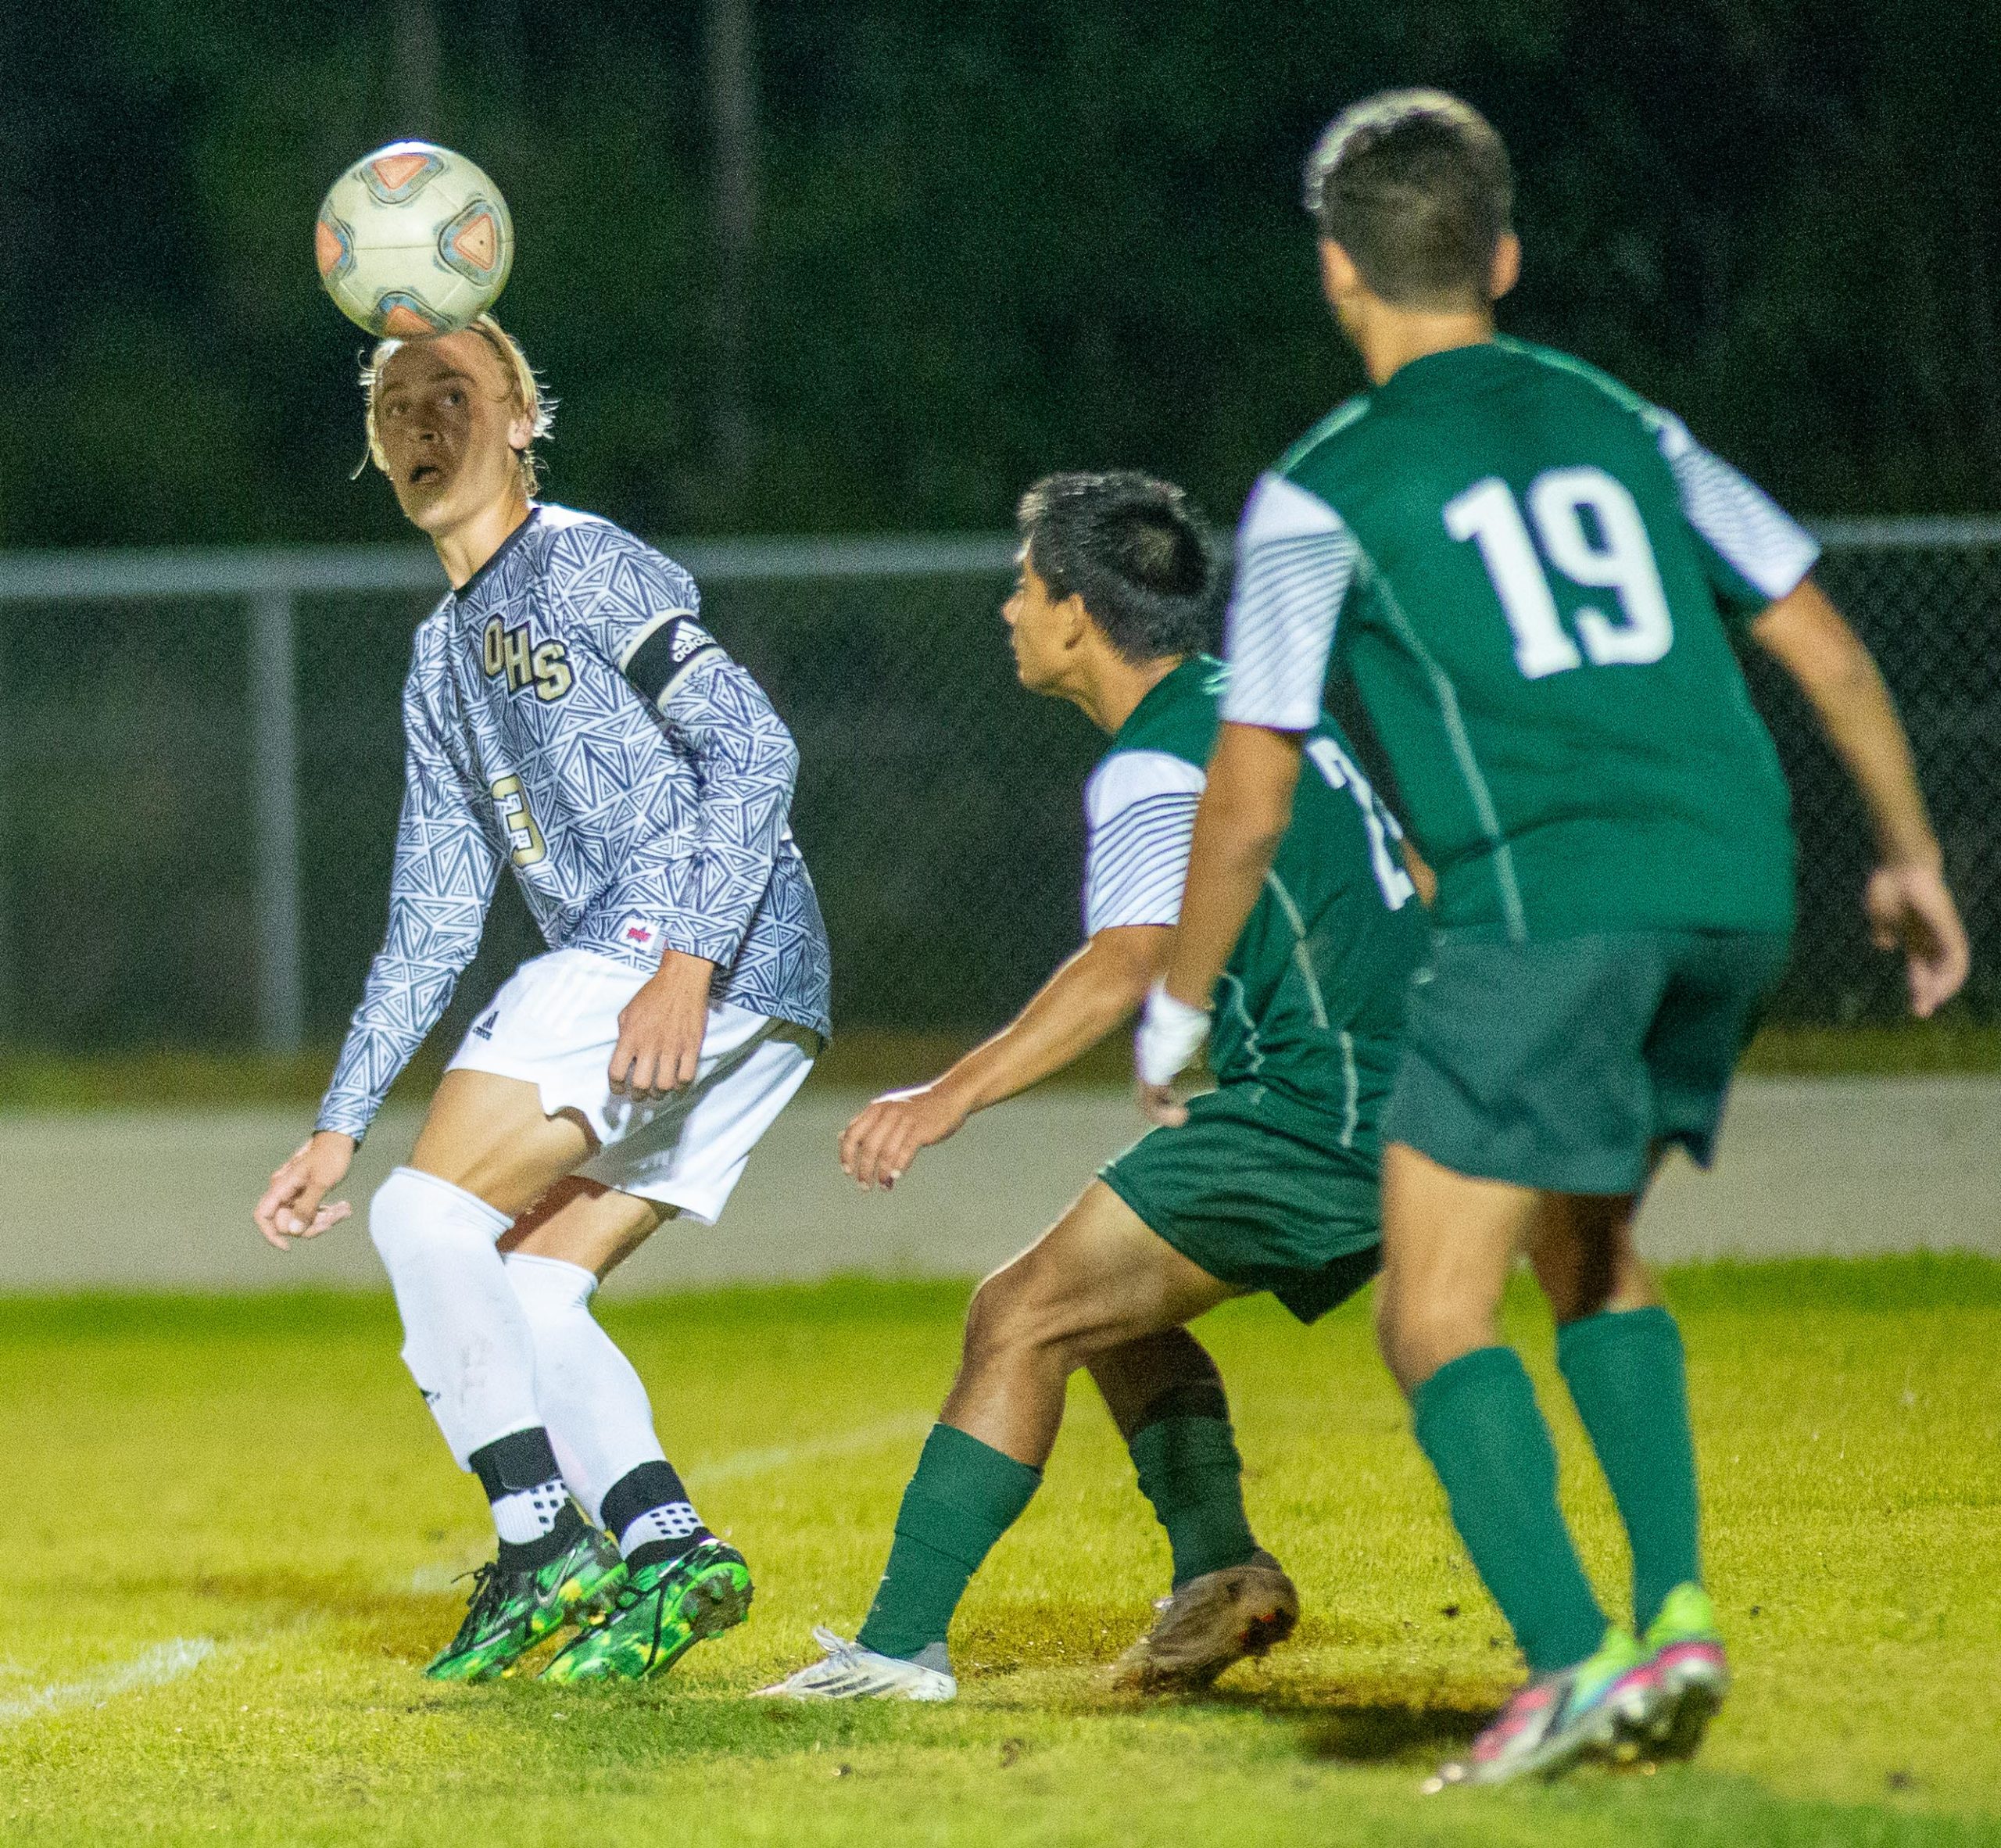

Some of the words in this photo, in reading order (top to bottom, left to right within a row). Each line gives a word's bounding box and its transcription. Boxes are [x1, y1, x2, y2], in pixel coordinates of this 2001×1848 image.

[1444, 467, 1674, 679] 19
[483, 613, 575, 701] OHS
[492, 775, 547, 868] 3
